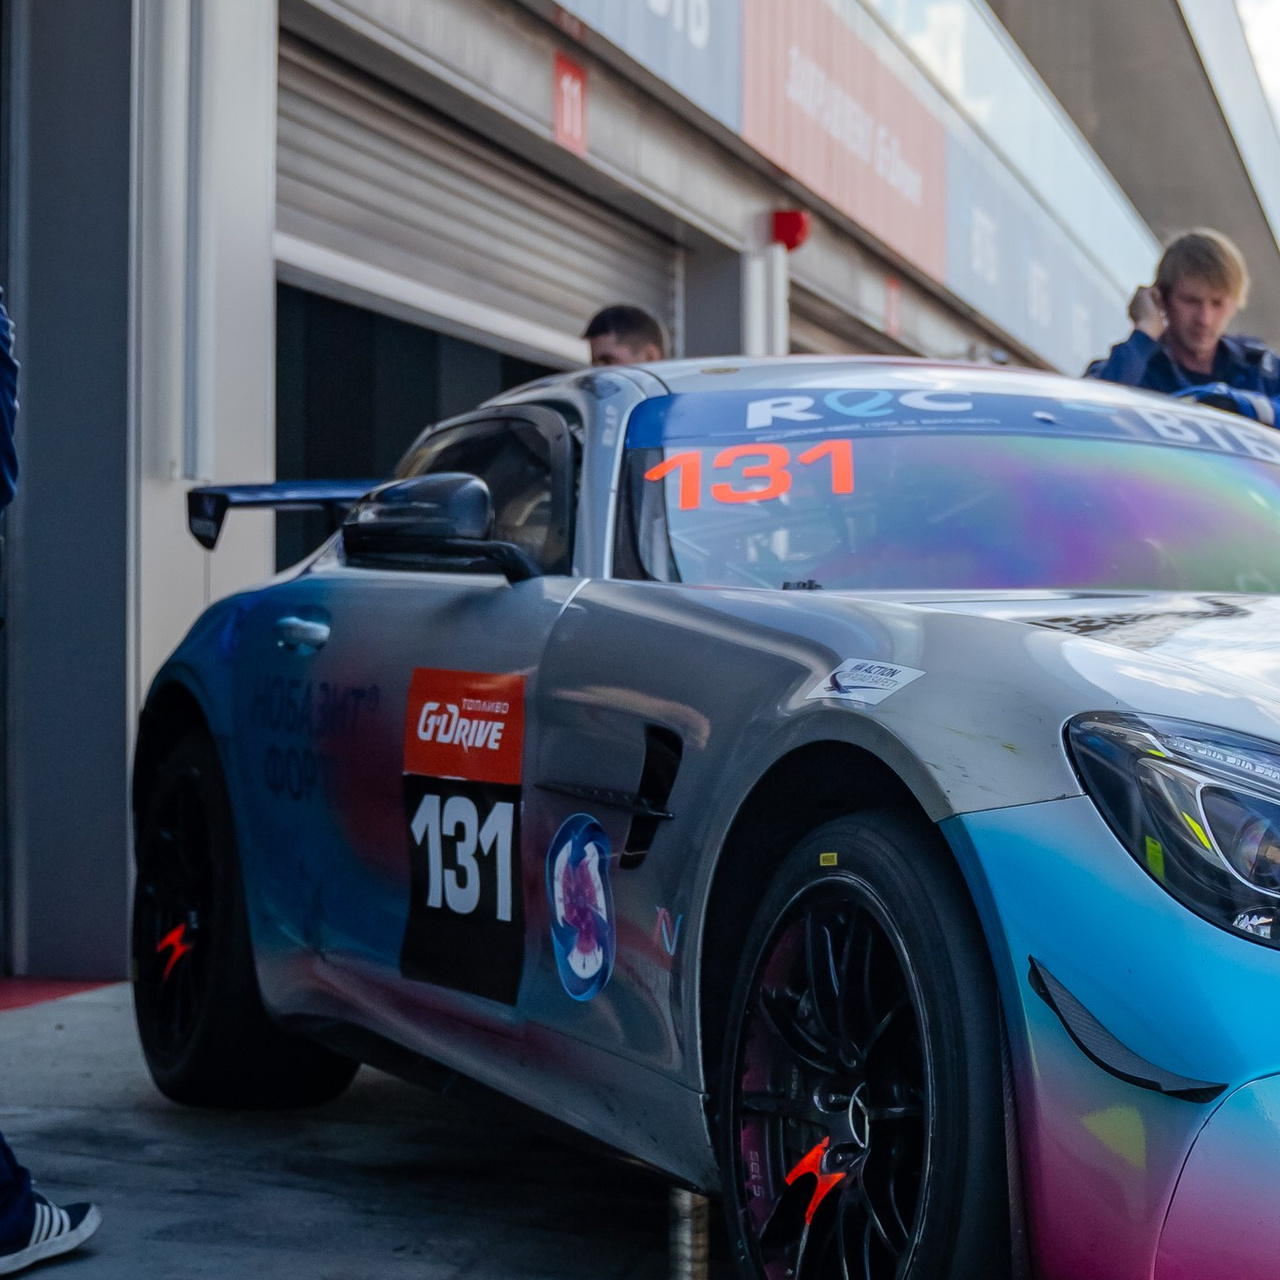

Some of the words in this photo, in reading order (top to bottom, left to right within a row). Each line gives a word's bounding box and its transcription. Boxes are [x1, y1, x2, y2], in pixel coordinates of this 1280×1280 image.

[644, 439, 855, 511] 131
[861, 664, 902, 678] ACTION
[410, 793, 515, 922] 131
